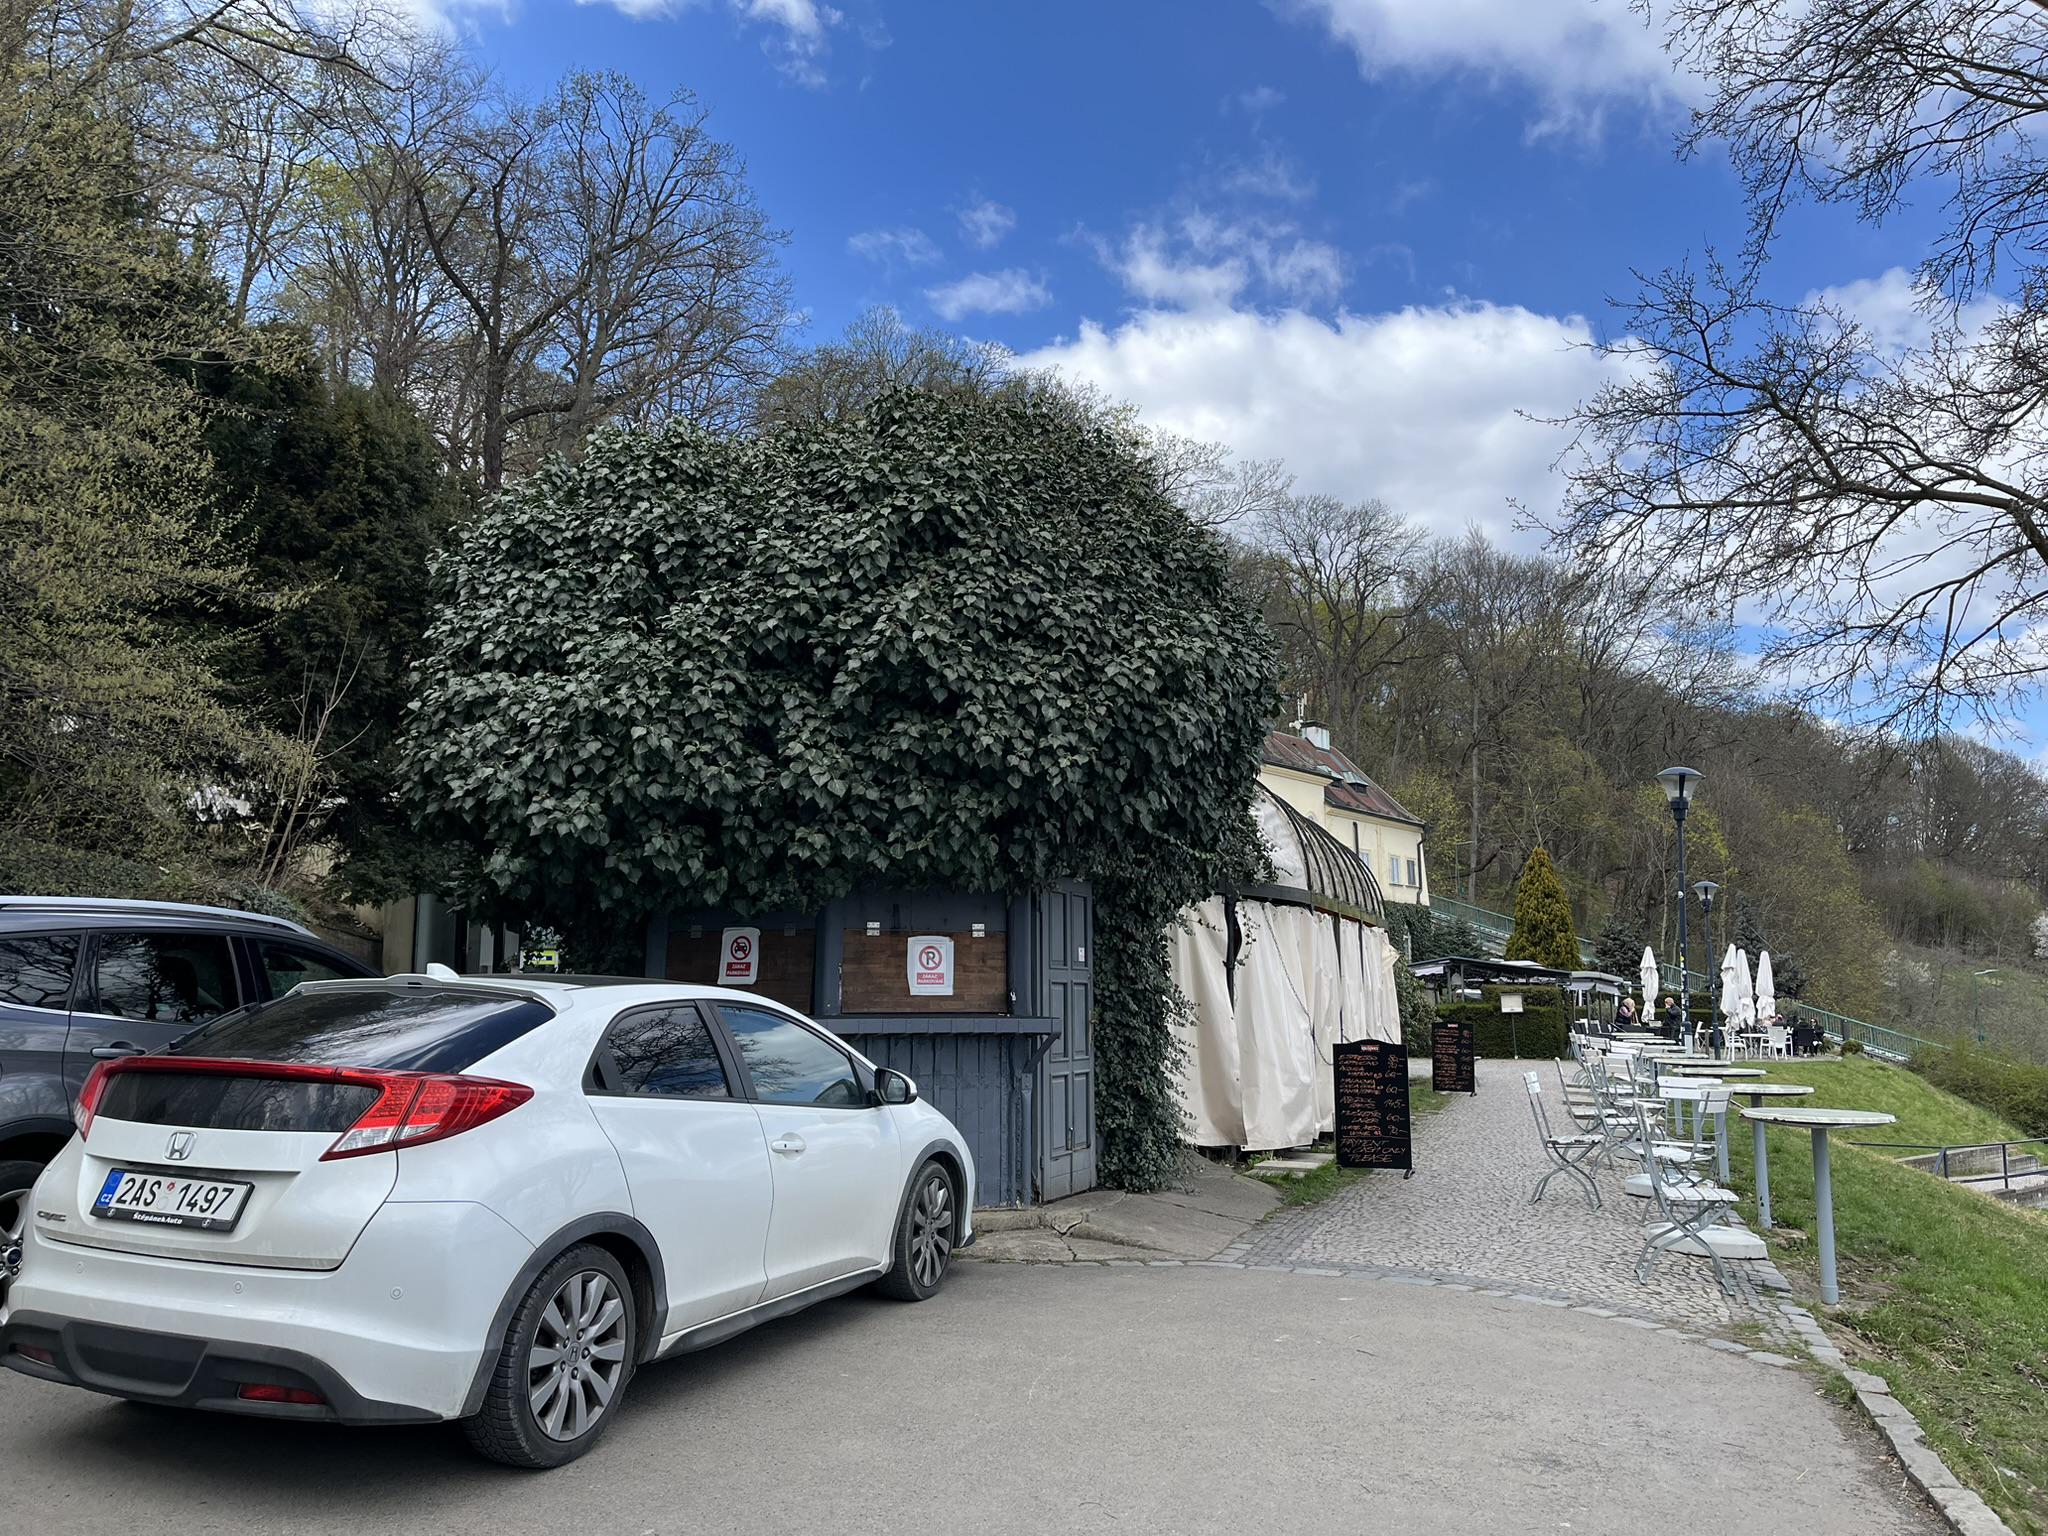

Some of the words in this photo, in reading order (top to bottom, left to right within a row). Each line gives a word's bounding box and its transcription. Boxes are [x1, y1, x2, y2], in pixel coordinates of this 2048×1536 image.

[100, 1193, 112, 1203] CZ
[115, 1177, 162, 1207] 2AS
[175, 1183, 235, 1215] 1497
